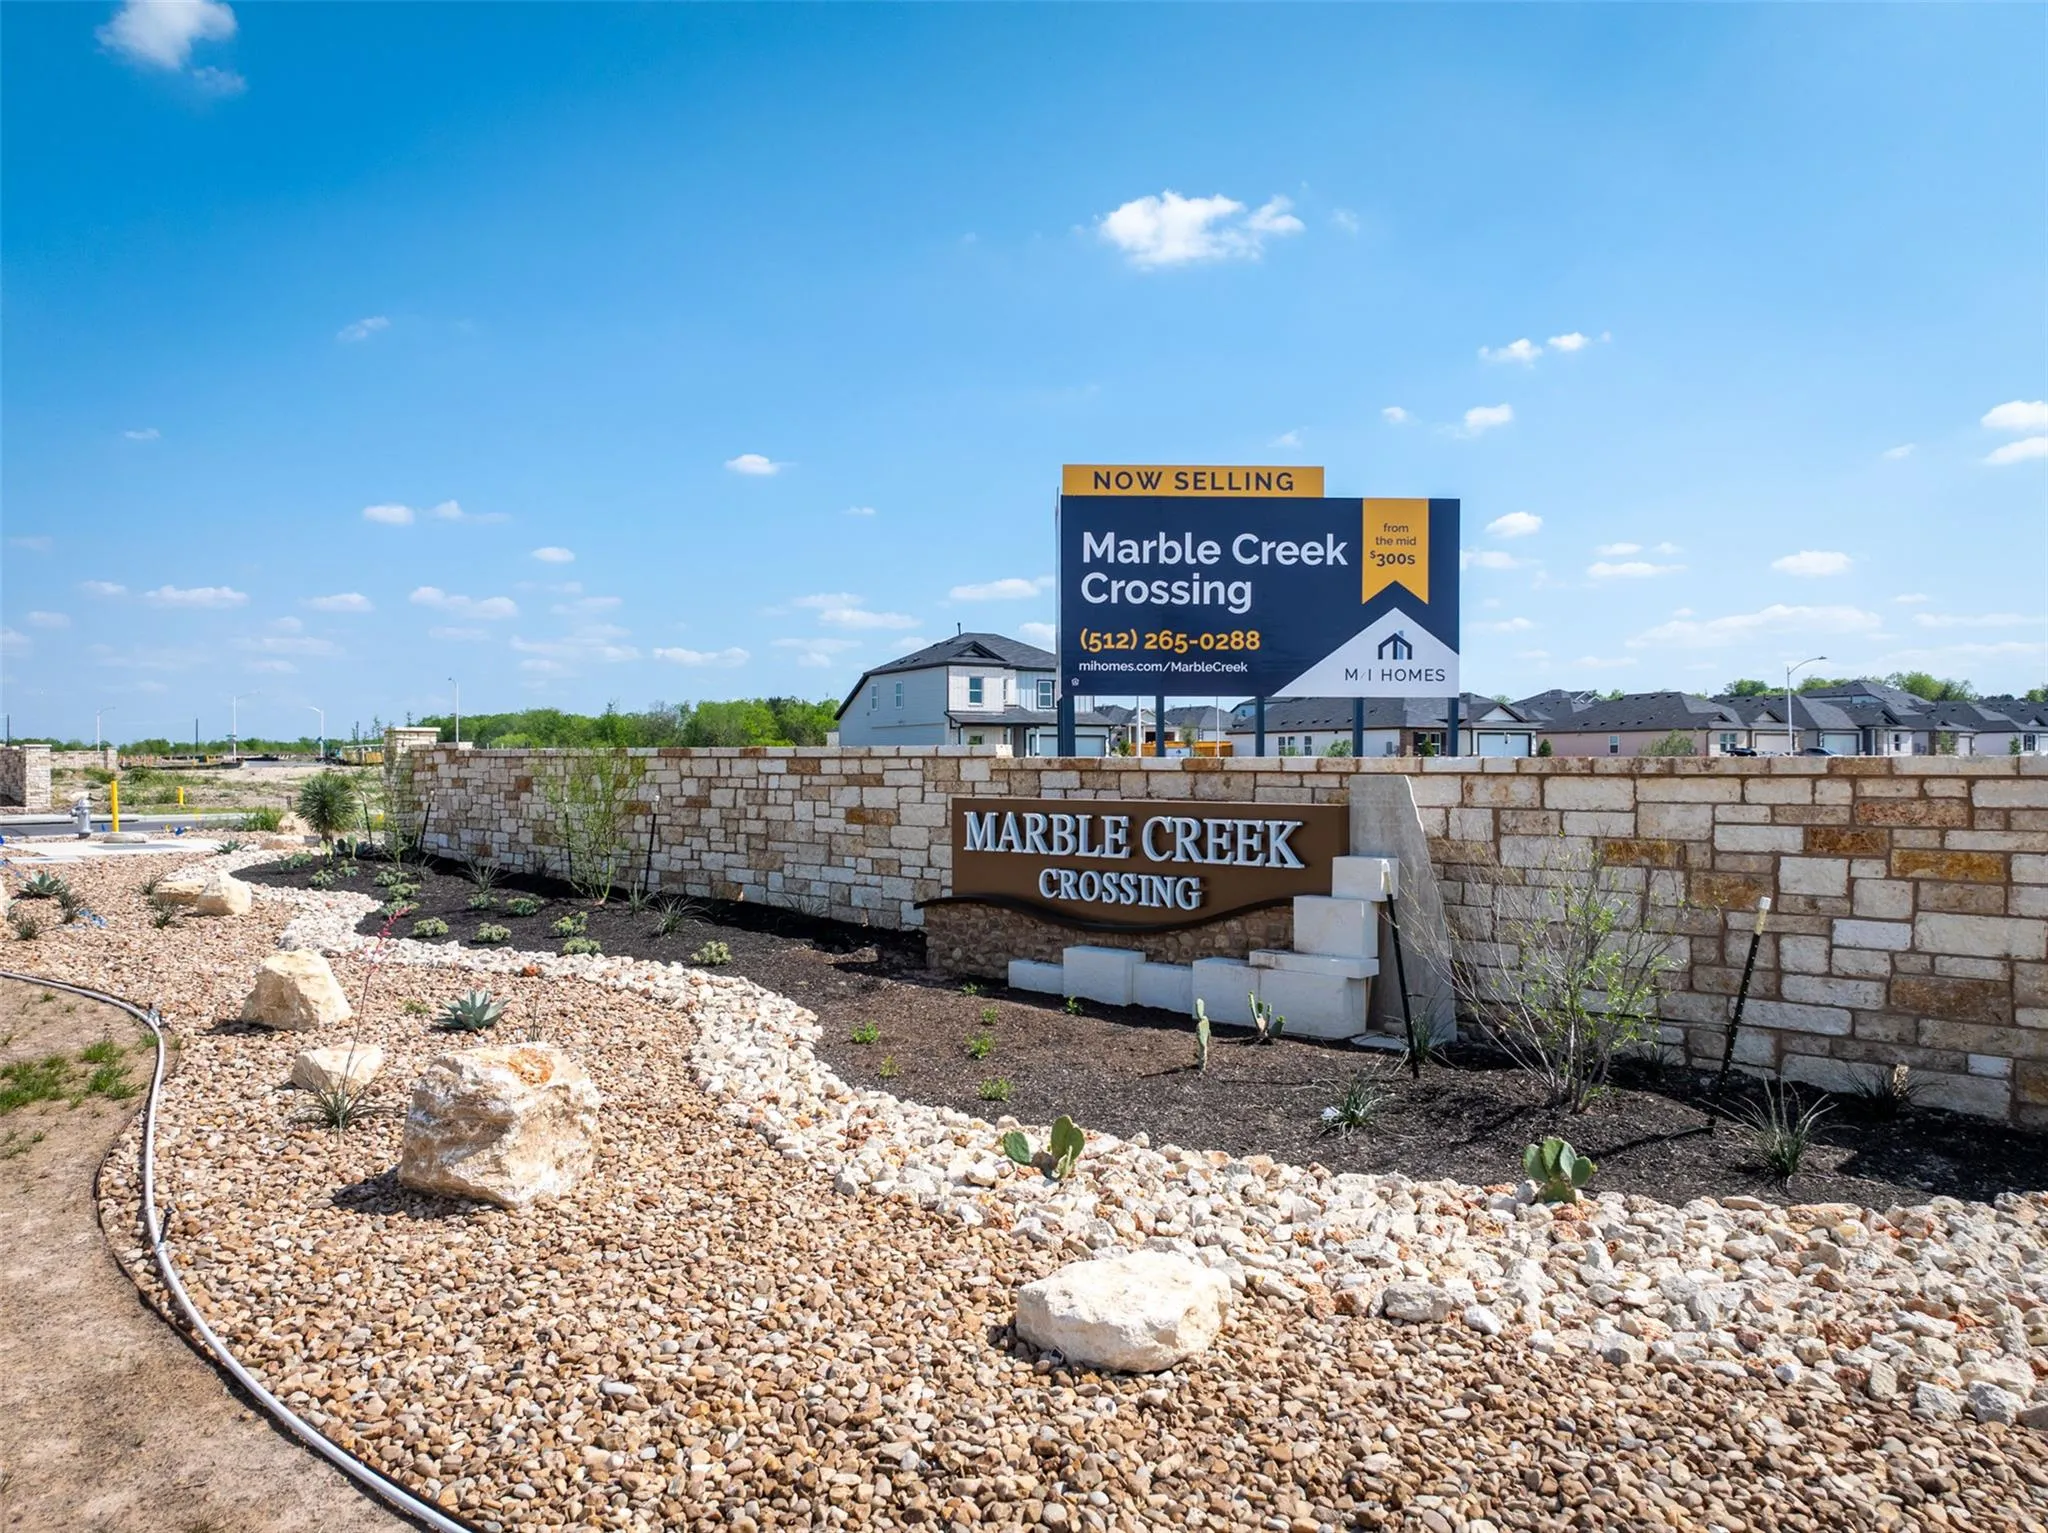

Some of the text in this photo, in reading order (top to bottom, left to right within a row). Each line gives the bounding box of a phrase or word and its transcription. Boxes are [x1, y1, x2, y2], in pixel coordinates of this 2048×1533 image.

[1093, 471, 1295, 491] NOW SELLING
[1383, 522, 1409, 533] from
[1083, 531, 1348, 566] Marble Creek
[1375, 536, 1417, 546] the mid
[1370, 551, 1416, 567] $300s
[1081, 572, 1252, 614] Crossing
[1080, 629, 1260, 654] (512) 265-0288
[1079, 661, 1248, 673] mihomes.com/MarbleCreek
[1381, 669, 1445, 682] HOMES
[964, 811, 1305, 869] MARBLE CREEK
[1039, 868, 1202, 910] CROSSING
